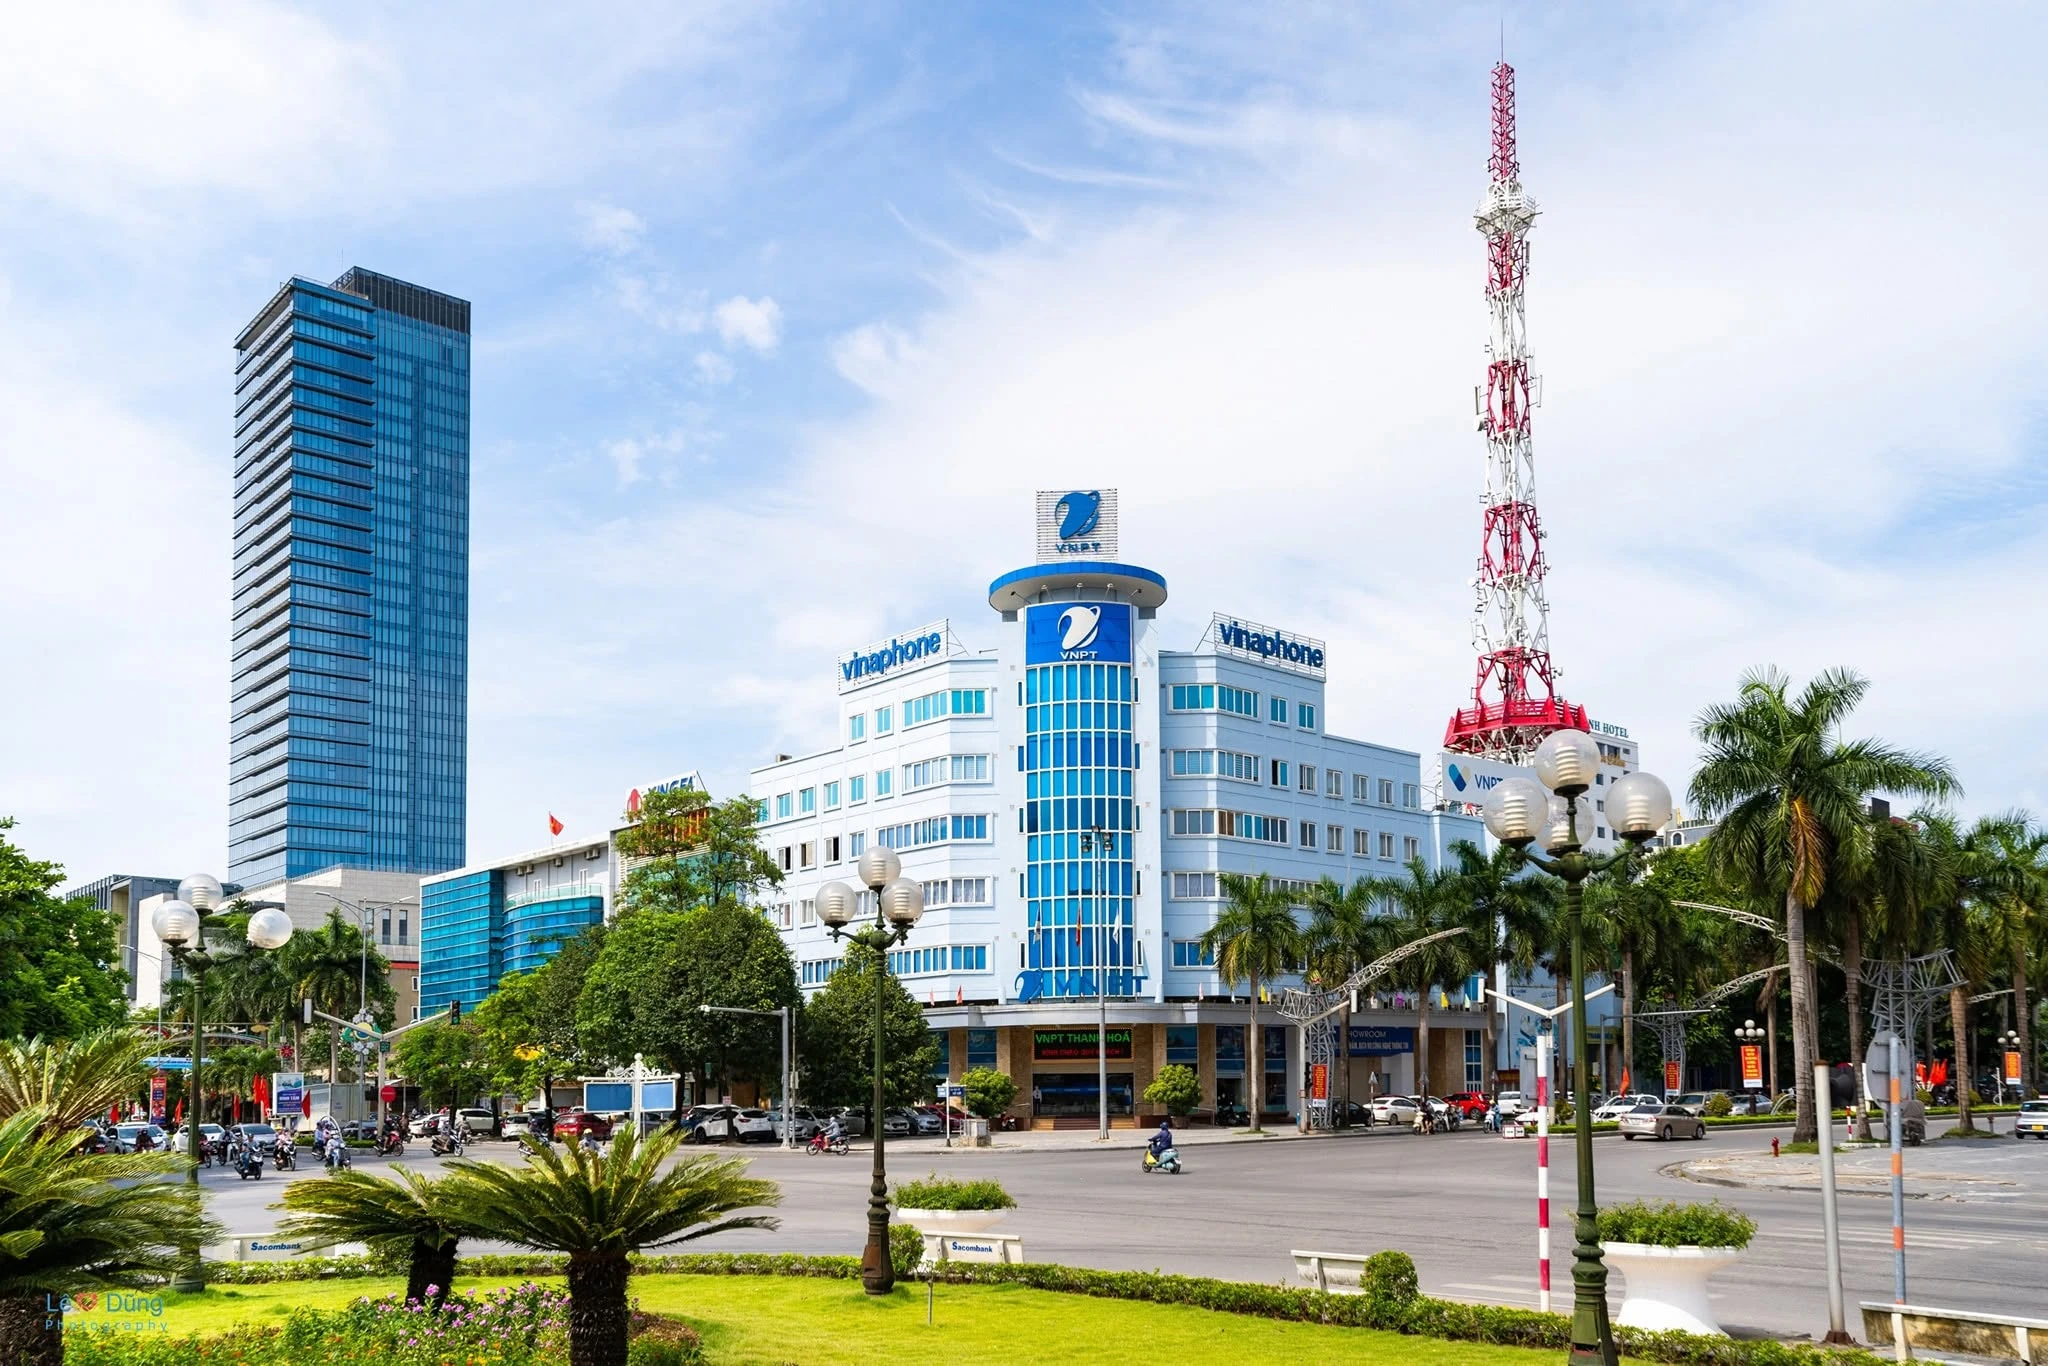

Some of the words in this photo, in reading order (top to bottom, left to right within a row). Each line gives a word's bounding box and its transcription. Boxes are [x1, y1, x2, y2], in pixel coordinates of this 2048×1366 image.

[1056, 542, 1100, 553] VNPT
[1220, 621, 1324, 668] vinaphone
[842, 632, 941, 681] vinaphone
[1060, 651, 1098, 660] VNPT
[1603, 722, 1629, 738] HOTEL
[1054, 976, 1148, 996] VNPT
[1035, 1033, 1065, 1044] VNPT
[1106, 1030, 1131, 1043] HOÁ
[1349, 1030, 1387, 1039] HOWROOM
[250, 1241, 302, 1251] Sacombank
[952, 1241, 993, 1253] Sacombank
